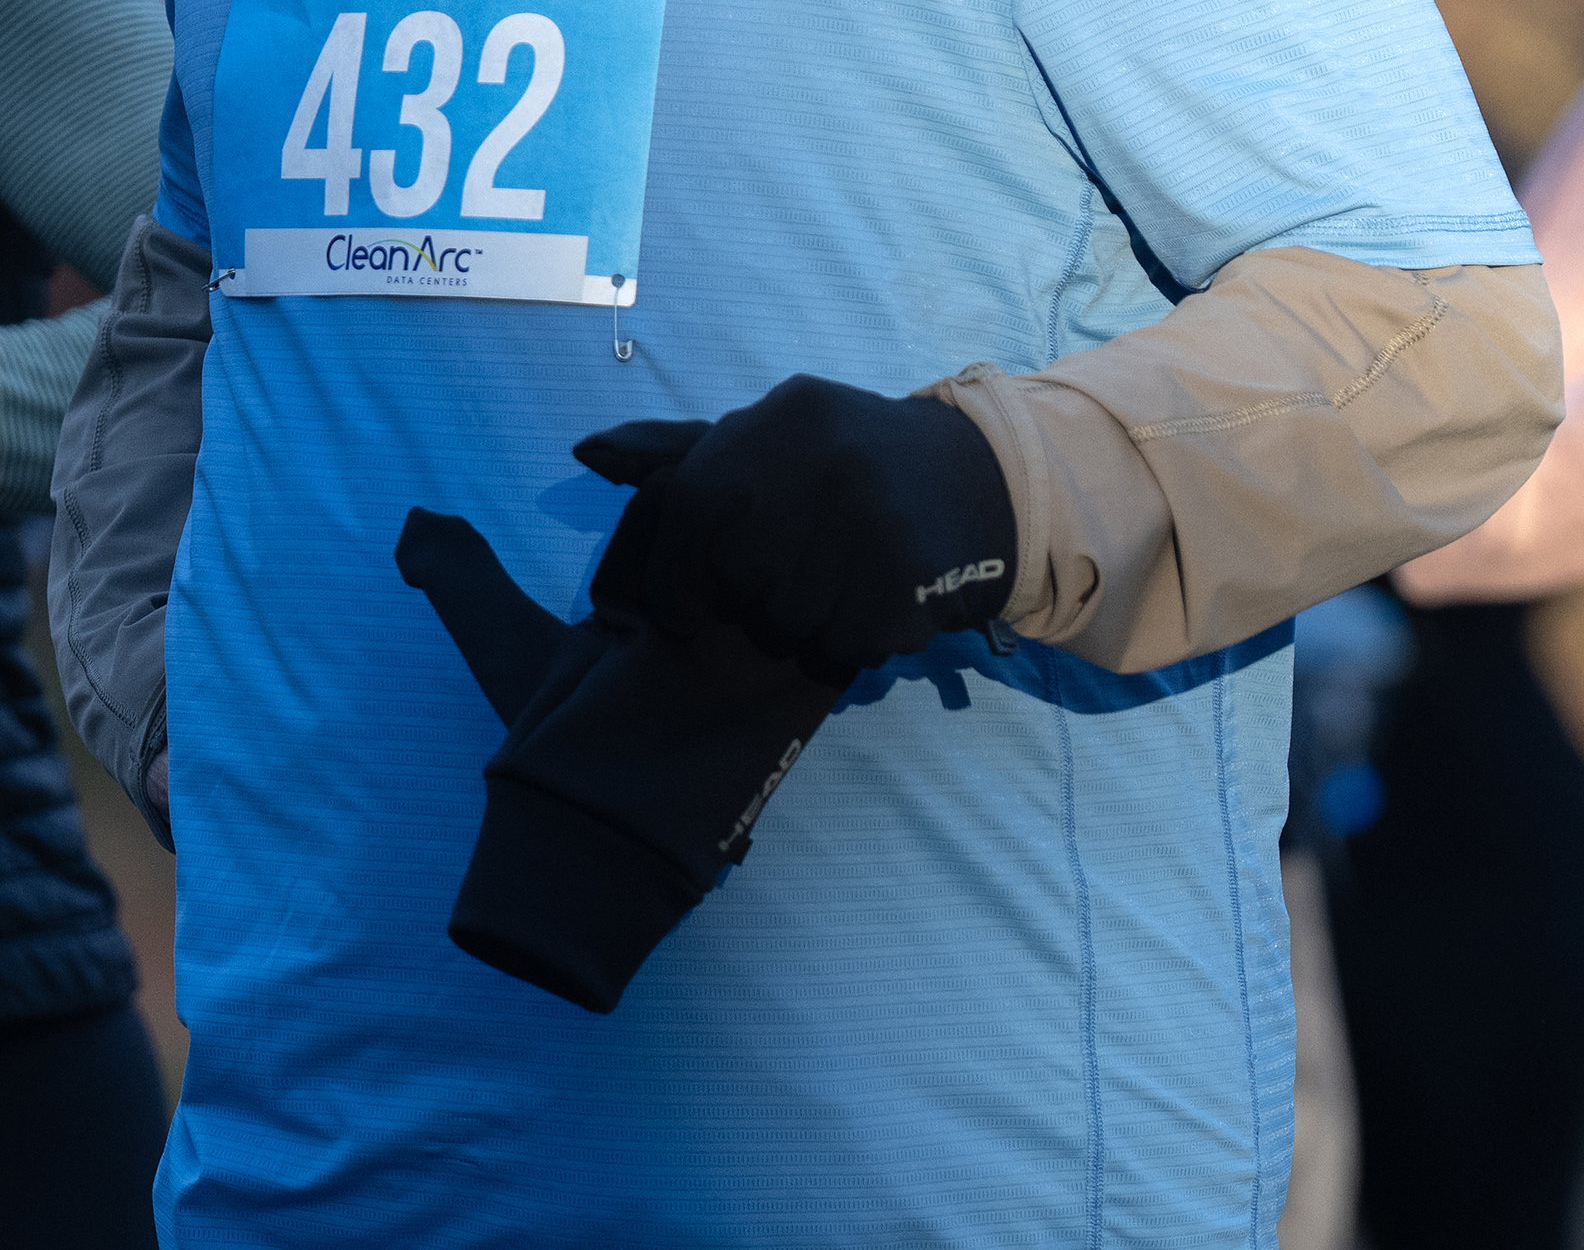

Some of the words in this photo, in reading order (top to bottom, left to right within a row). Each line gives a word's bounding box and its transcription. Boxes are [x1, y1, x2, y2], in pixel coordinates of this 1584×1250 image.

[281, 10, 566, 220] 432
[386, 275, 414, 285] DATA
[419, 276, 468, 287] CENTERS
[915, 558, 1005, 603] HEAD
